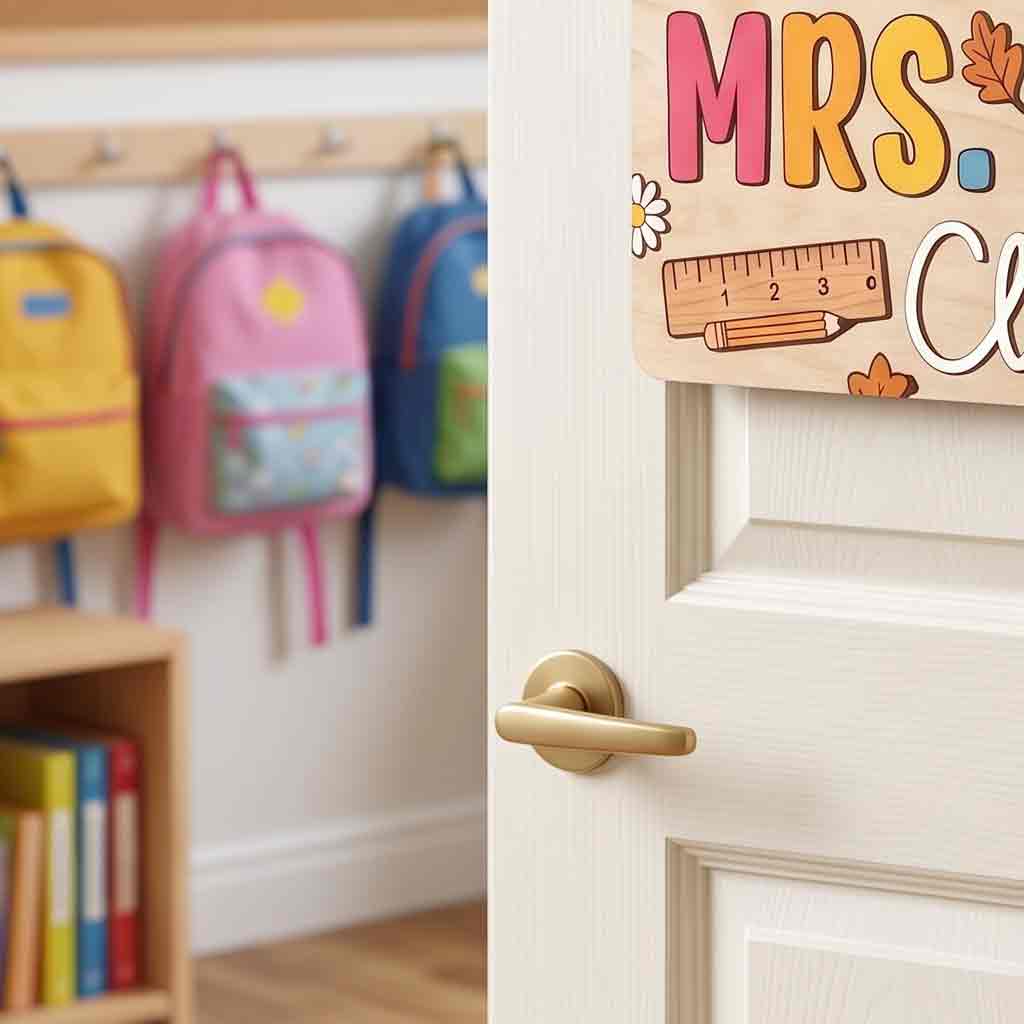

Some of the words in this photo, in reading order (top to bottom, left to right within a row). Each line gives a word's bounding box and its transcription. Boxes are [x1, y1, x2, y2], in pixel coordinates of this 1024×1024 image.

[665, 10, 997, 198] MRS.
[720, 288, 730, 307] 1
[769, 282, 781, 301] 2
[817, 277, 830, 296] 3
